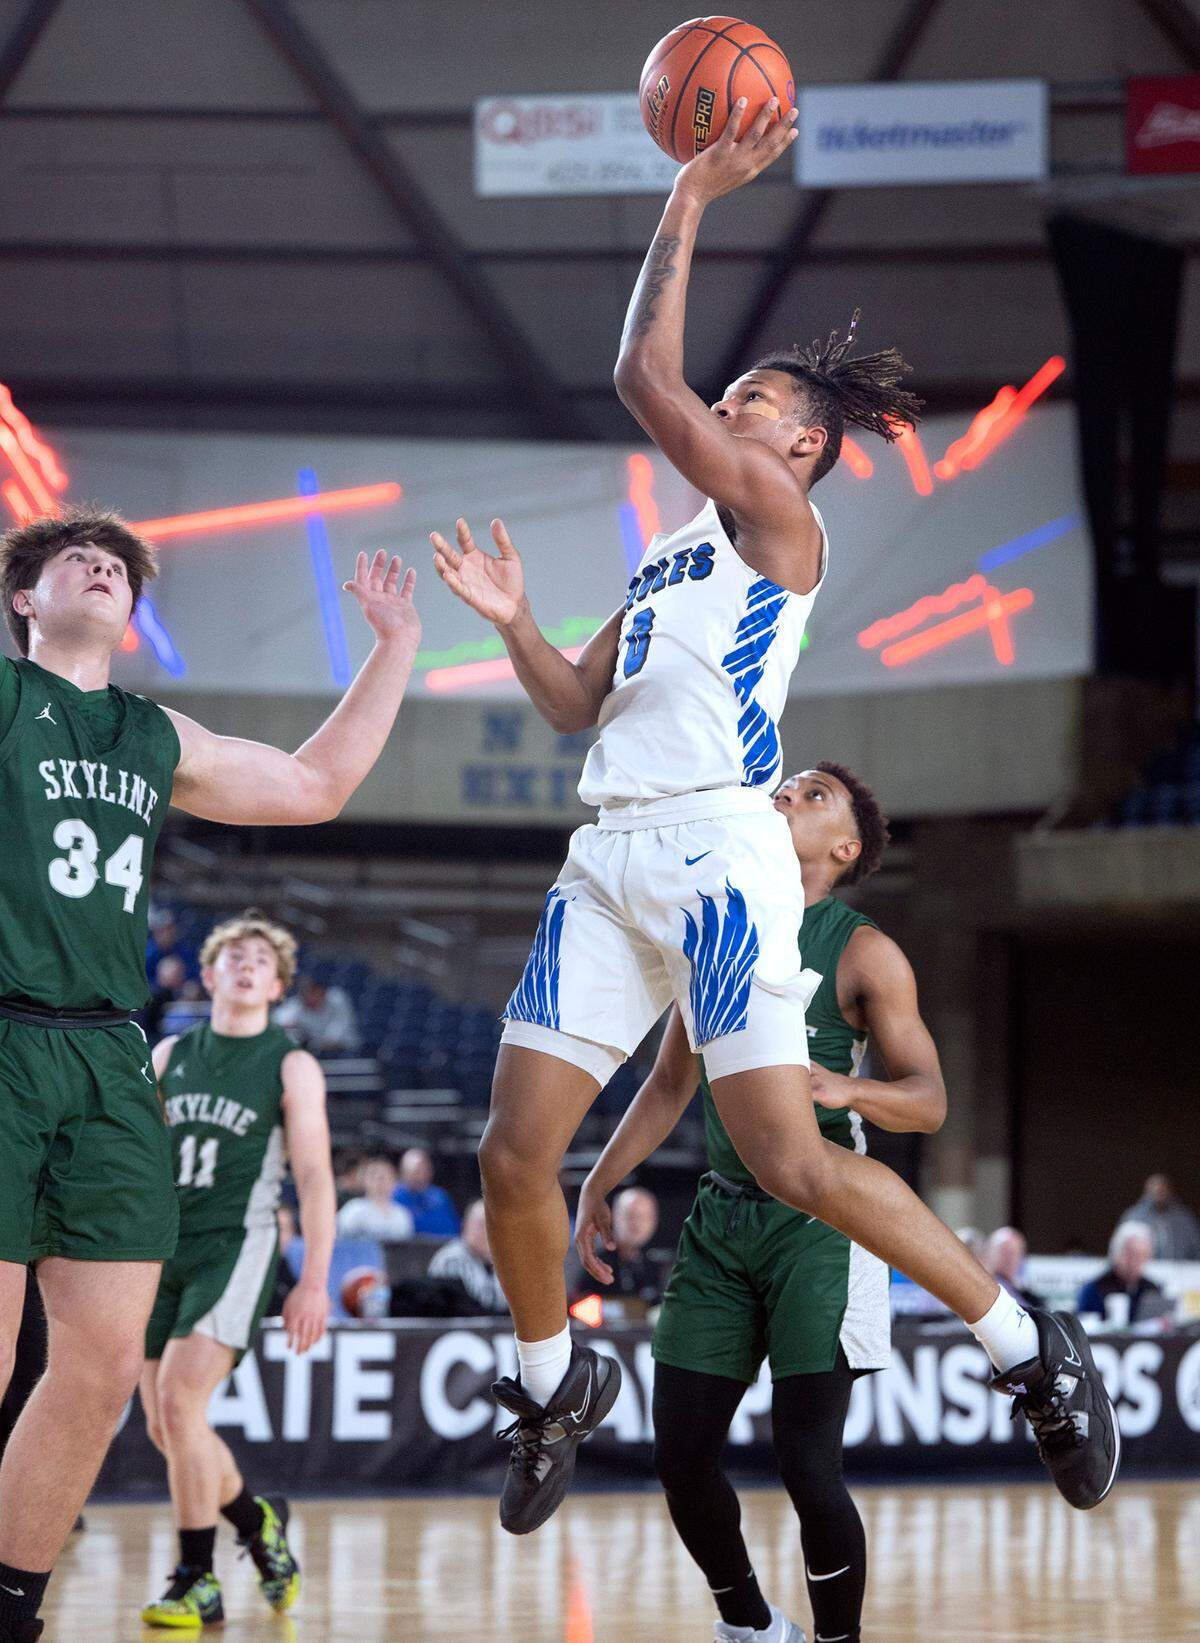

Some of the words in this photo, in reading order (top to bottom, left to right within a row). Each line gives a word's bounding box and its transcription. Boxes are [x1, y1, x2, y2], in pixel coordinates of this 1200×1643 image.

[623, 606, 657, 680] 0
[38, 758, 159, 827] SKYLINE
[48, 817, 145, 914] 34
[177, 1134, 219, 1188] 11
[205, 1331, 396, 1443] ATE
